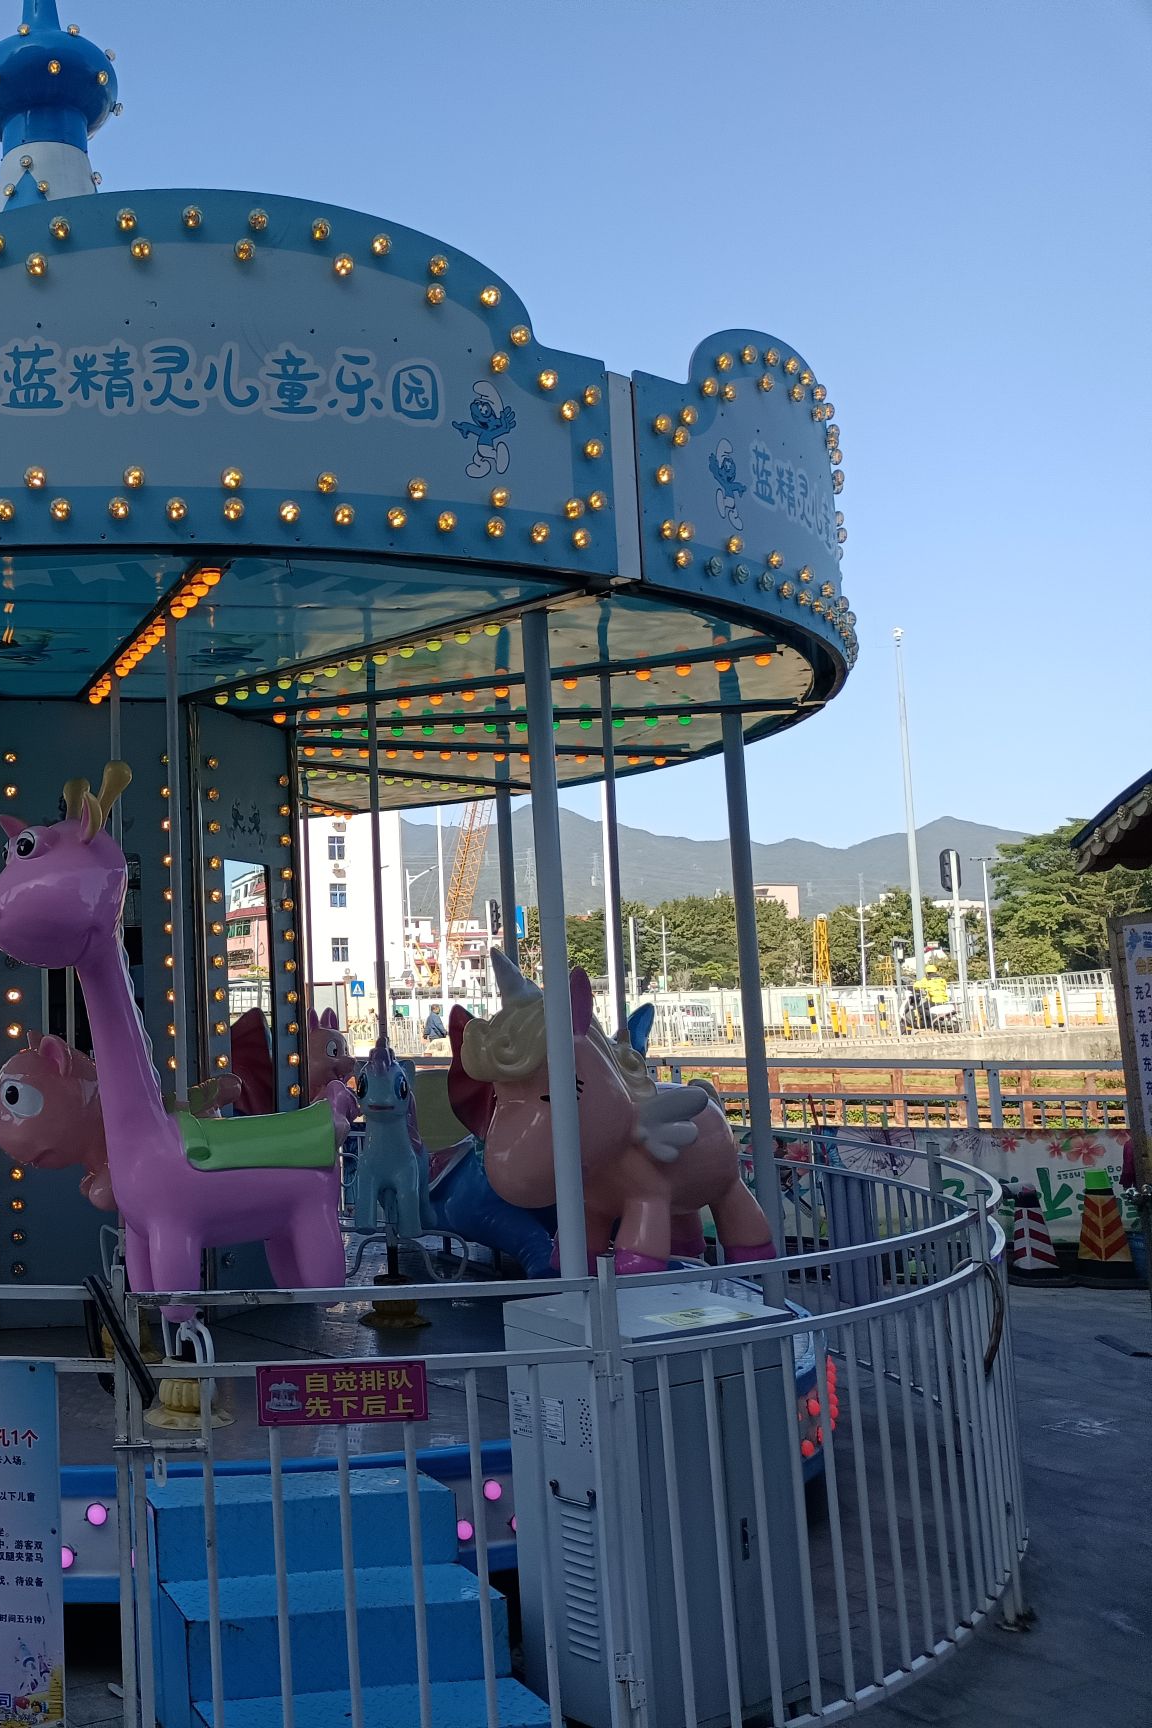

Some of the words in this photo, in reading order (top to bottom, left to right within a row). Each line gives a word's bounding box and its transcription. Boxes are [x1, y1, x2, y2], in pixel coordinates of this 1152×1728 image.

[2, 344, 439, 421] 蓝精灵儿童乐园
[305, 1369, 413, 1393] 自觉排队
[305, 1394, 415, 1418] 先下后上
